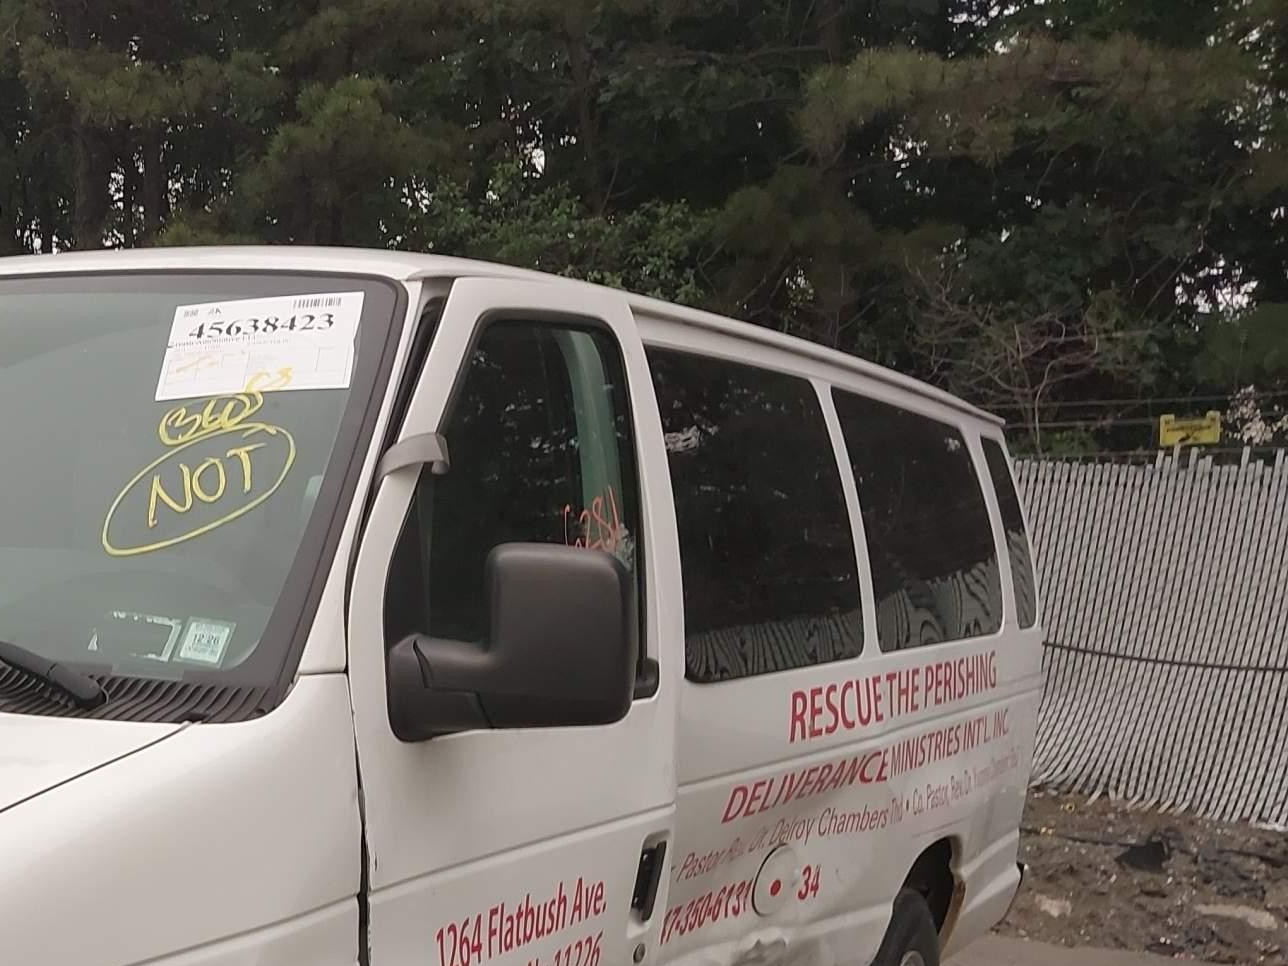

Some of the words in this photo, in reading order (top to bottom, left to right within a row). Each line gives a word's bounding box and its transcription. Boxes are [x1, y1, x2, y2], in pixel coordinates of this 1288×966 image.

[188, 312, 335, 340] 45638423
[148, 443, 266, 527] NOT
[789, 675, 884, 743] RESCUE
[886, 667, 920, 718] THE
[924, 651, 997, 708] PERISHING
[721, 748, 889, 824] DELIVERANCE
[890, 723, 960, 778] MINISTRIES
[818, 804, 890, 836] Chambers
[487, 881, 568, 959] Flatbush
[570, 876, 607, 926] Ave.
